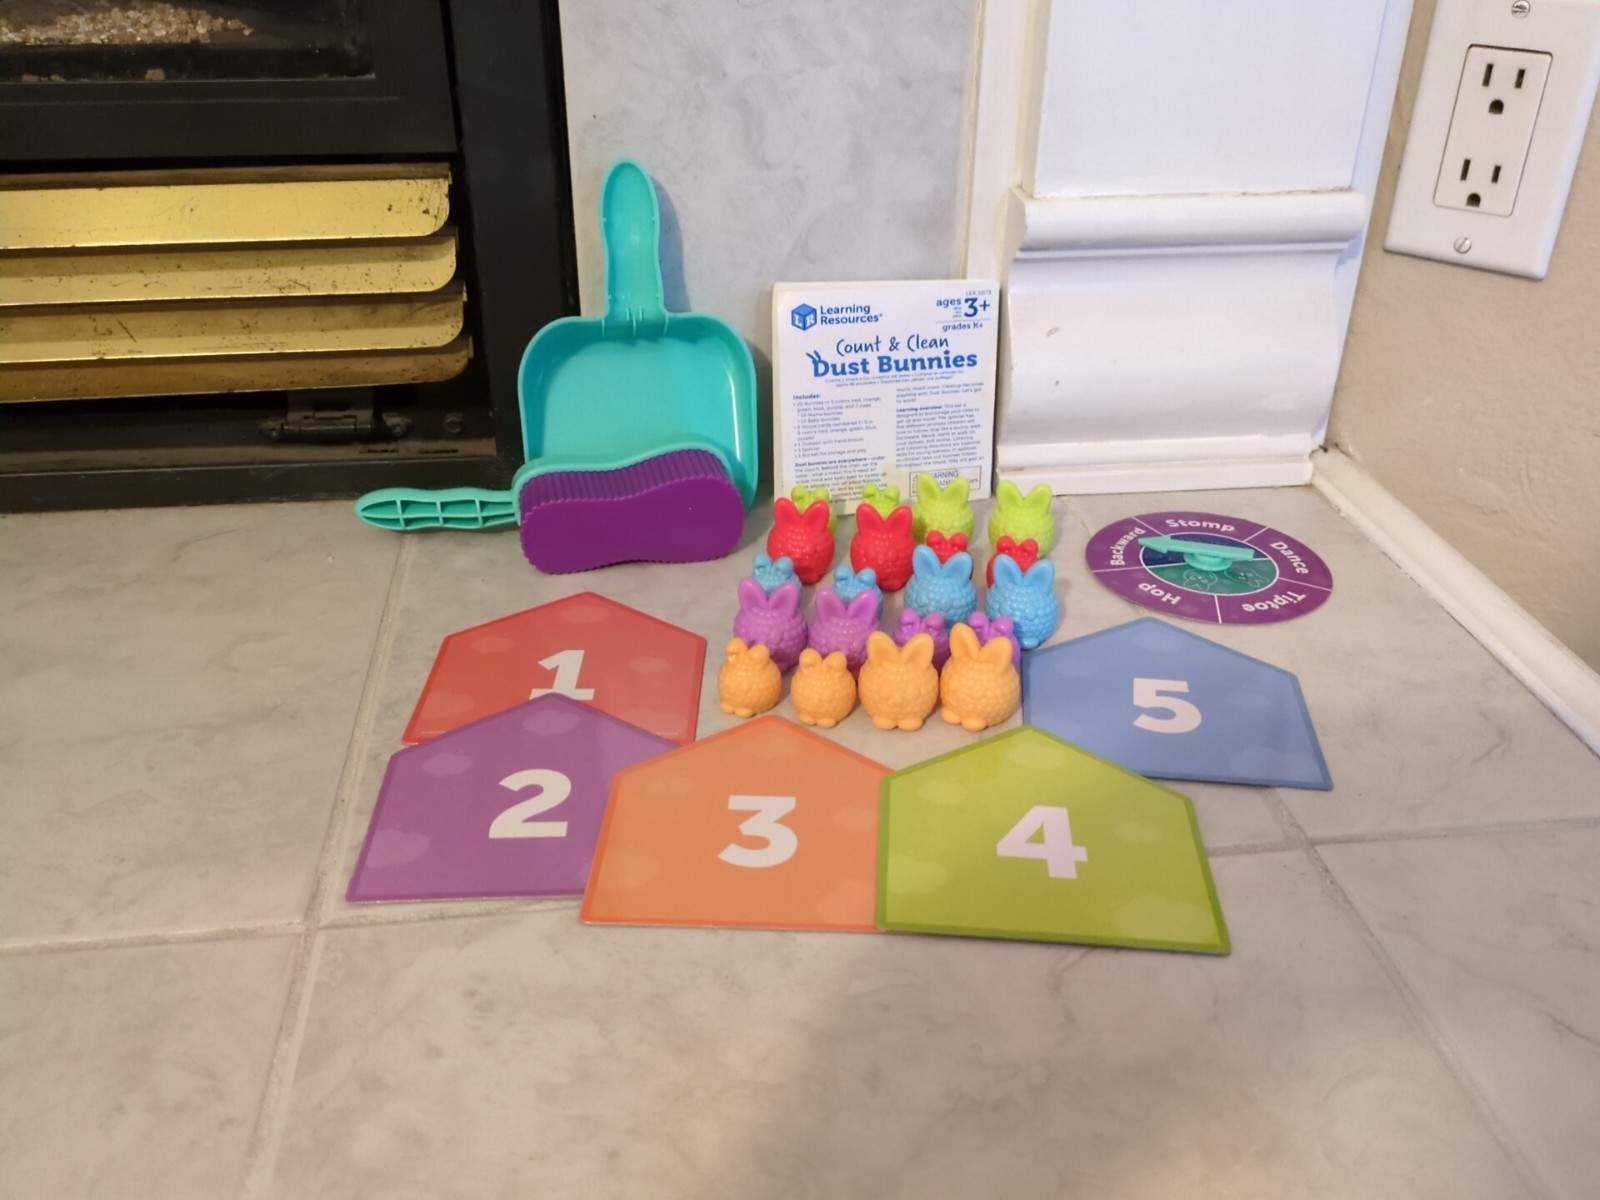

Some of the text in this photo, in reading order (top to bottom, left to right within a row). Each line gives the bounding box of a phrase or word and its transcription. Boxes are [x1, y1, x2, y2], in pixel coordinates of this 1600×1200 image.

[820, 304, 871, 315] Learning
[936, 297, 990, 318] ages 3+
[942, 320, 984, 332] grades K+
[836, 334, 949, 357] Count & Clean
[811, 355, 870, 378] Dust
[877, 349, 978, 374] Bunnies
[1165, 519, 1236, 533] Stomp
[1110, 526, 1147, 566] Backward
[1270, 541, 1309, 575] Dance
[1138, 582, 1182, 606] Hop
[1241, 591, 1306, 612] Tiptoe
[529, 650, 595, 700] 1
[1132, 677, 1202, 734] 5
[488, 769, 572, 839] 2
[718, 795, 798, 868] 3
[996, 805, 1088, 879] 4
